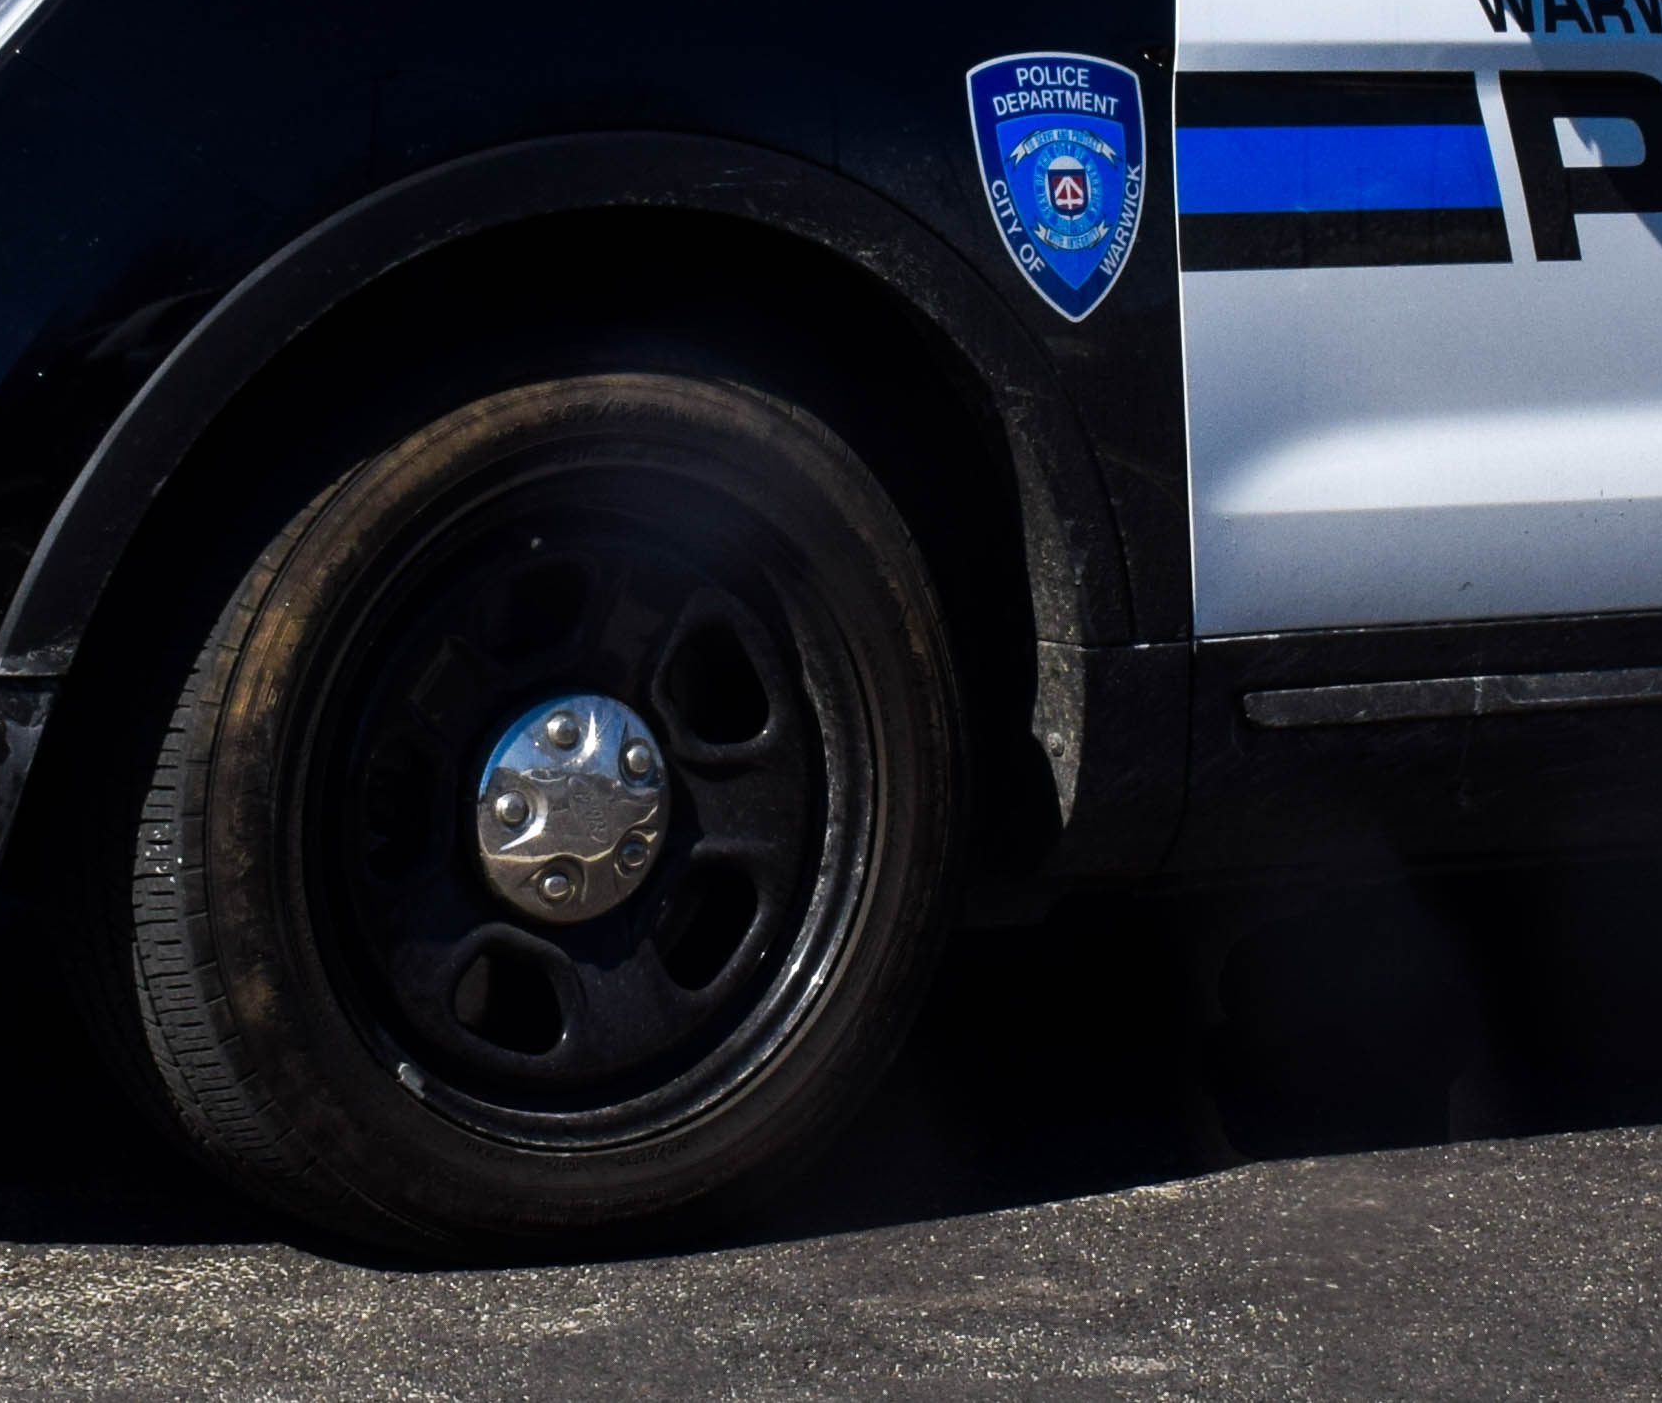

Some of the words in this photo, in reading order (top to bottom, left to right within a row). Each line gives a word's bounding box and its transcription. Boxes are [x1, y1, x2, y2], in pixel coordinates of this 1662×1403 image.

[1016, 66, 1090, 88] POLICE
[993, 90, 1119, 116] DEPARTMENT
[991, 180, 1023, 235] CITY
[1019, 244, 1045, 273] OF
[1099, 164, 1142, 276] WARWICK
